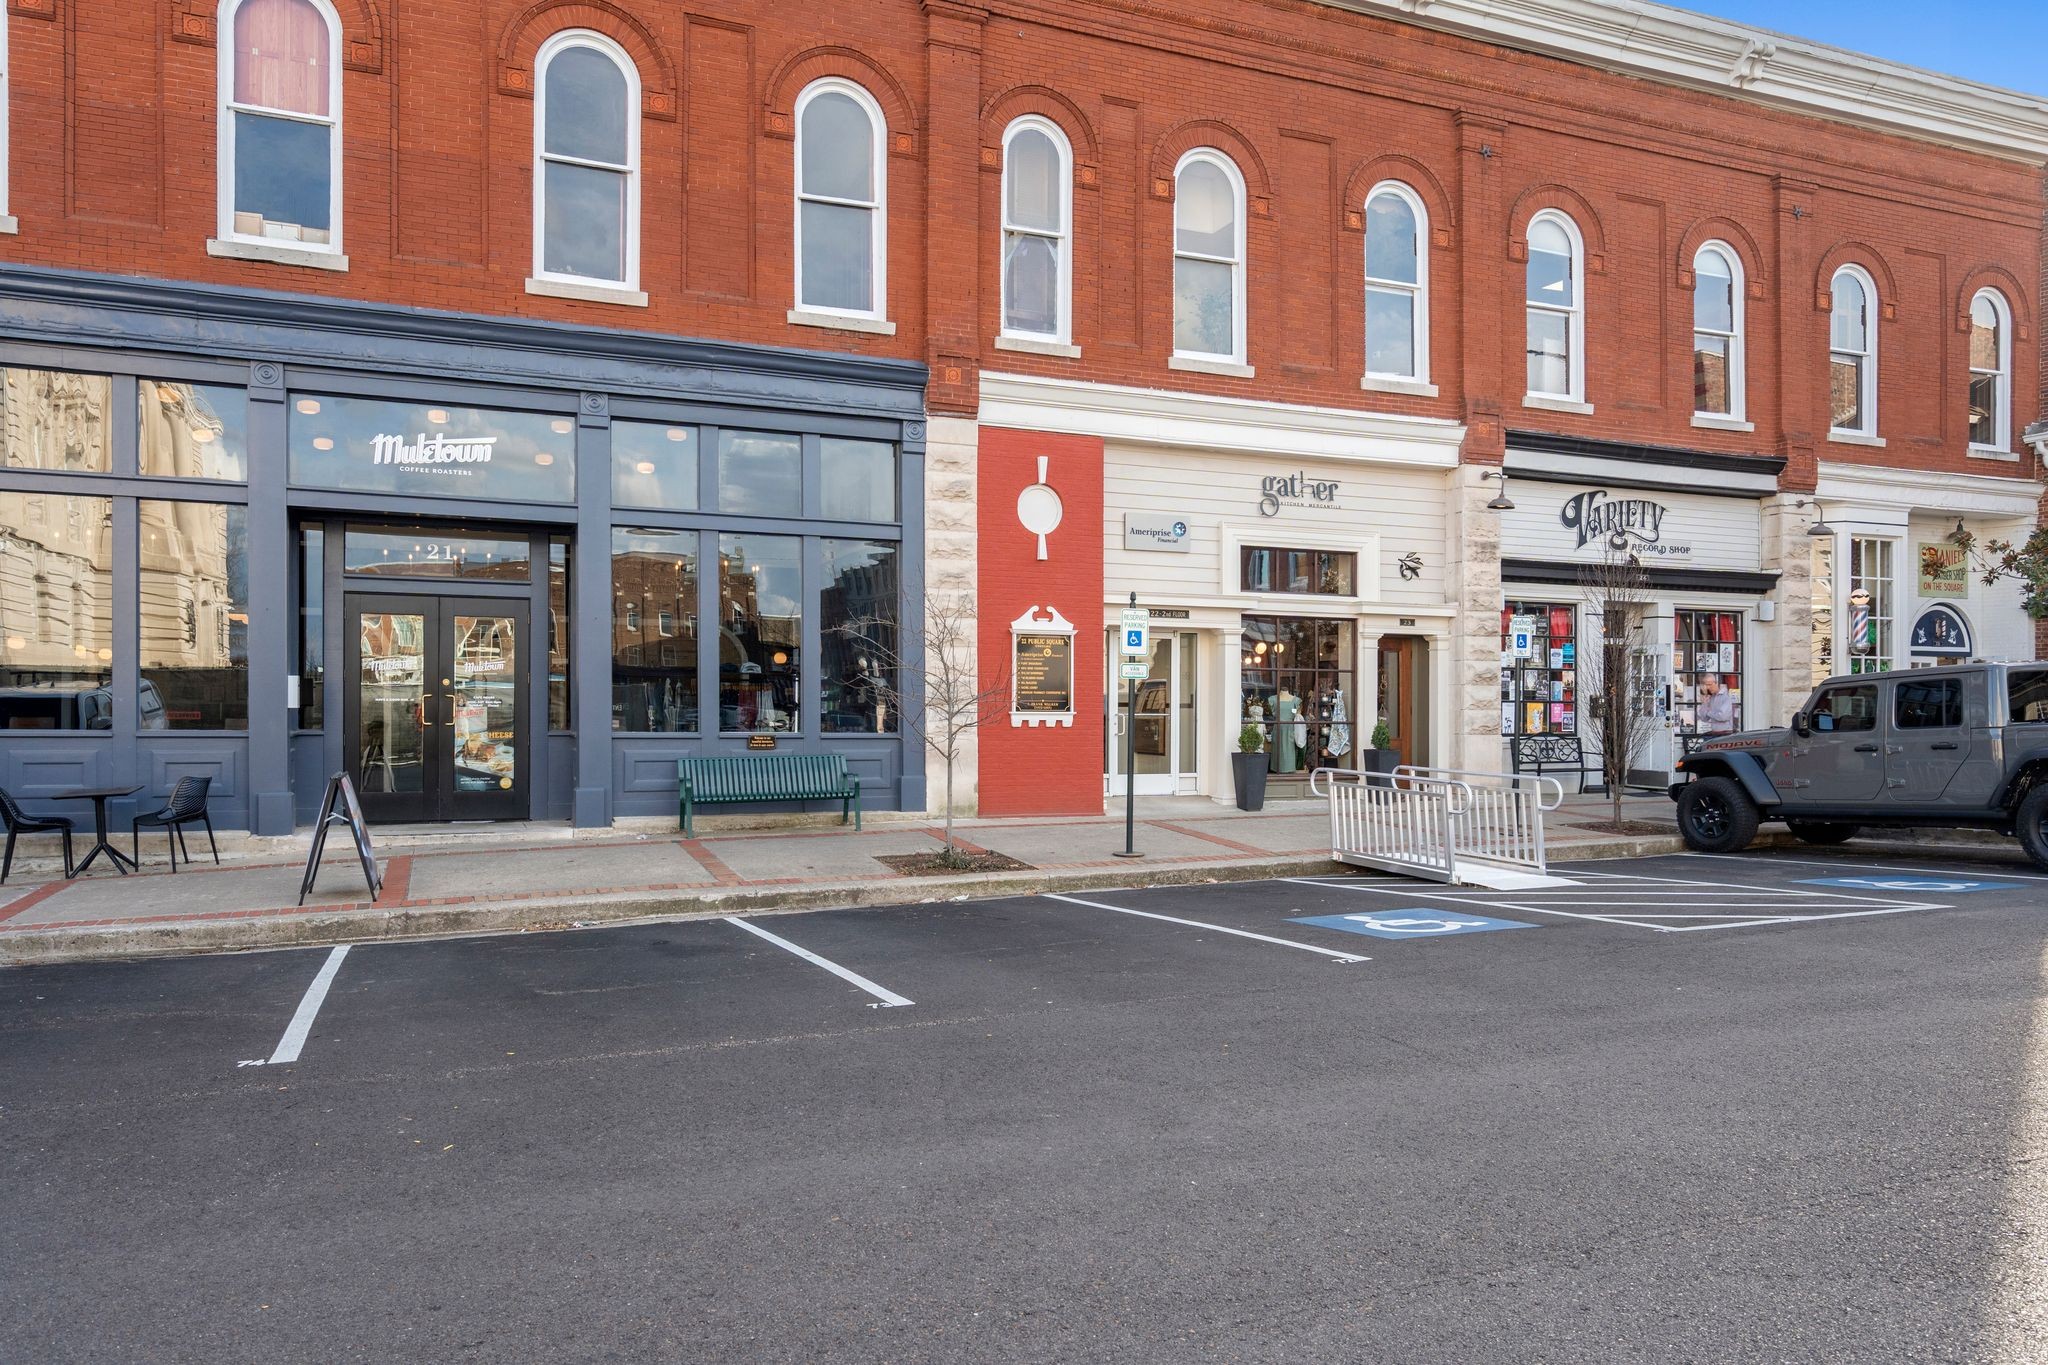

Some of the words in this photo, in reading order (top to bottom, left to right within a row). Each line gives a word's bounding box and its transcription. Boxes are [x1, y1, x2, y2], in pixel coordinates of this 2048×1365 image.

[369, 433, 497, 464] Muletown
[399, 466, 429, 474] COFFEE
[432, 468, 472, 476] ROASTERS
[1259, 470, 1341, 517] gather
[1129, 527, 1172, 538] Ameriprise
[426, 543, 453, 560] 21
[1631, 543, 1667, 555] RECORD
[1668, 545, 1691, 554] SHOP
[1922, 581, 1932, 590] ON
[1932, 582, 1943, 591] THE
[1943, 583, 1964, 592] SQUARE
[1123, 613, 1148, 621] RESERVED
[1046, 638, 1065, 646] SQUARE
[1706, 739, 1763, 750] MOJAVE
